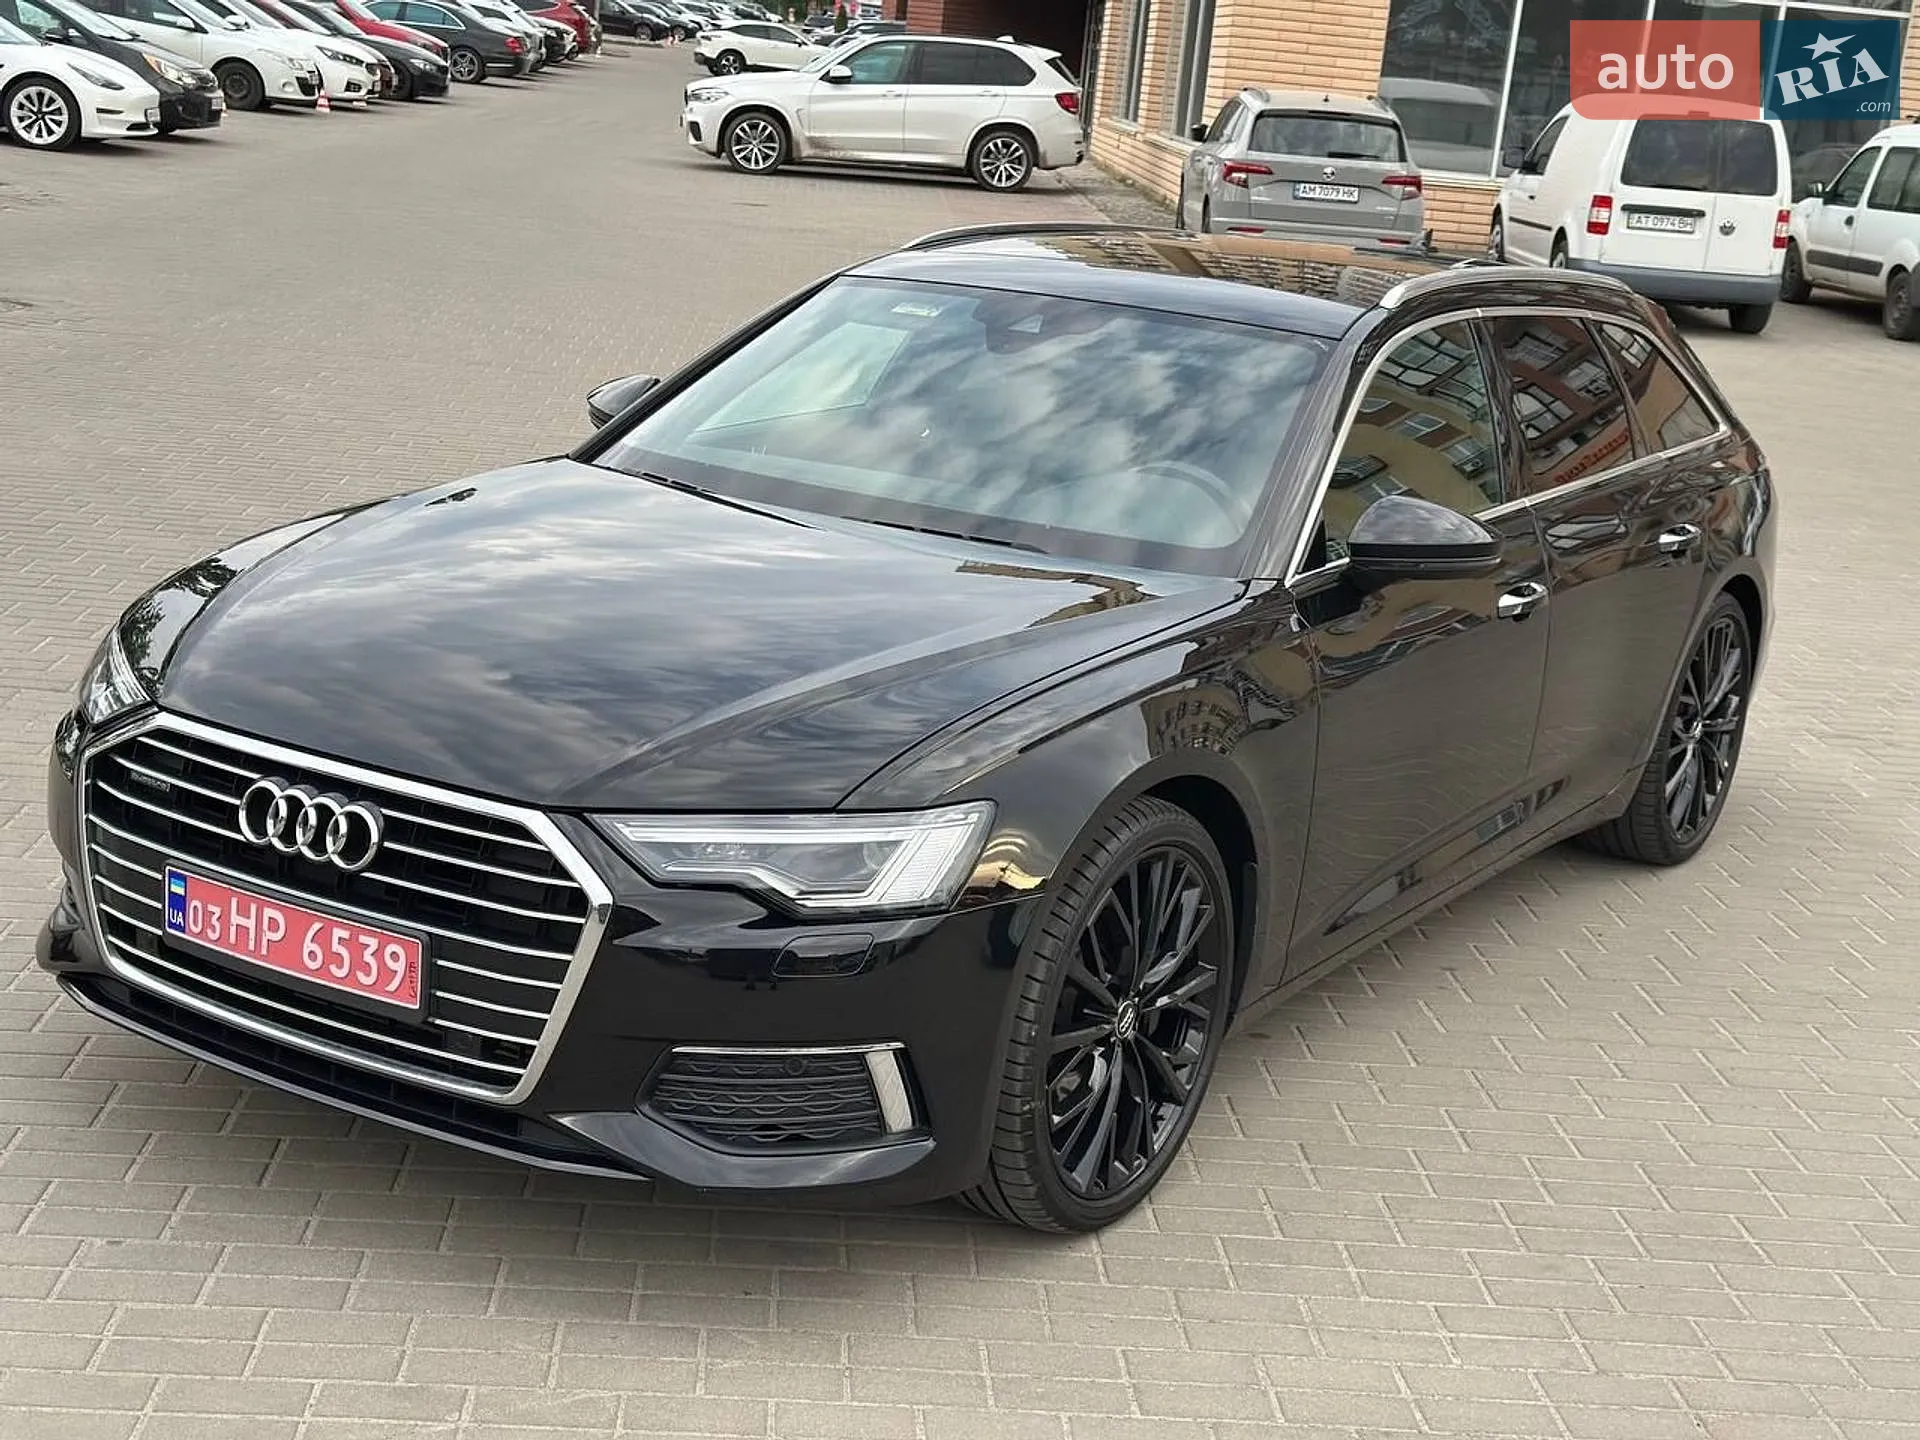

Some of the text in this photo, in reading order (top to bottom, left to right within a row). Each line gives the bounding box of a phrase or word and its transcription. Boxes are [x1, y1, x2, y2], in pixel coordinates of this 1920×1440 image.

[1300, 184, 1357, 199] AM 7079 HK
[1635, 214, 1694, 229] AT 0974 BH
[170, 914, 184, 927] UA
[188, 899, 222, 940] 03
[229, 896, 286, 956] HP
[302, 922, 407, 993] 6539
